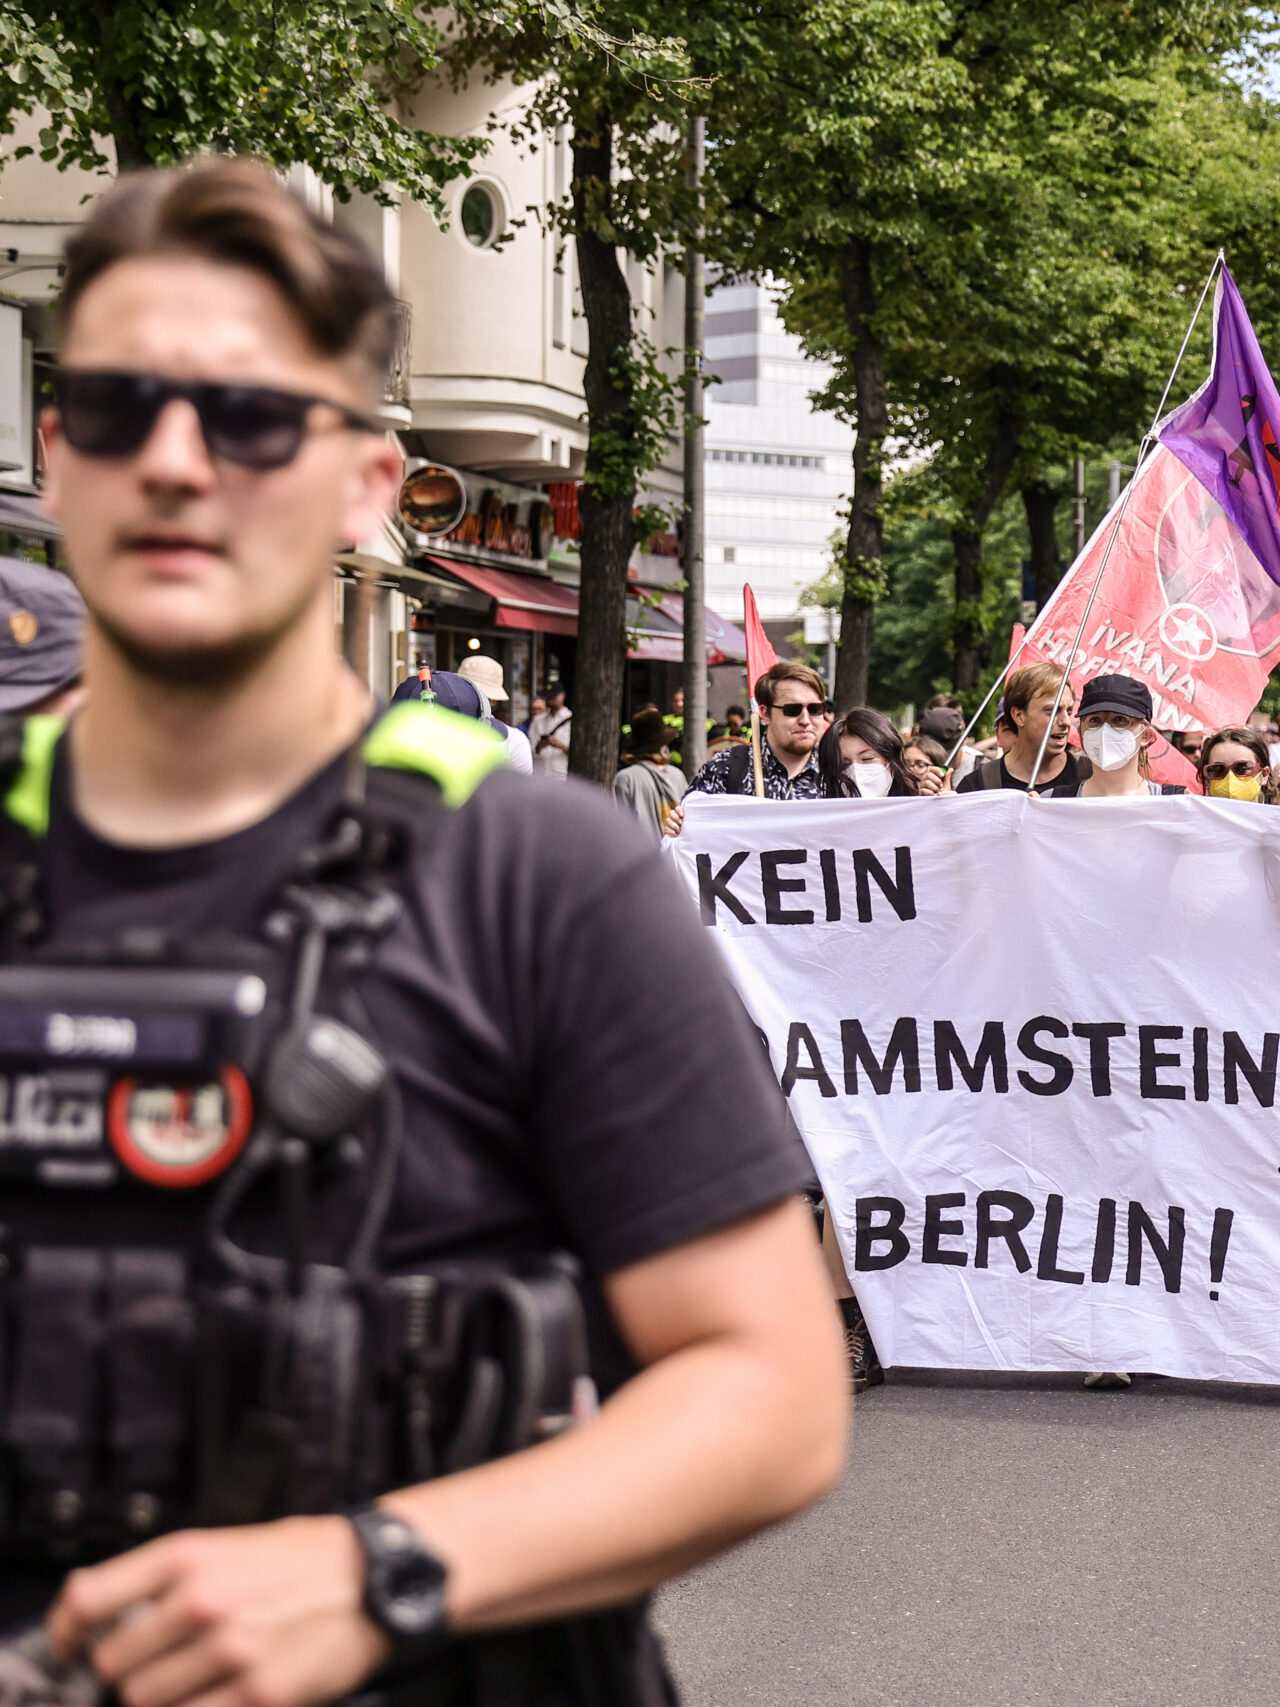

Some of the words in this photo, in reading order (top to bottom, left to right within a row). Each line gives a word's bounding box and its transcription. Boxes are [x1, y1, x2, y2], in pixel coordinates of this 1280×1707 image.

[696, 846, 916, 926] KEIN
[759, 1016, 1280, 1107] AMMSTEIN
[855, 1190, 1233, 1300] BERLIN!
